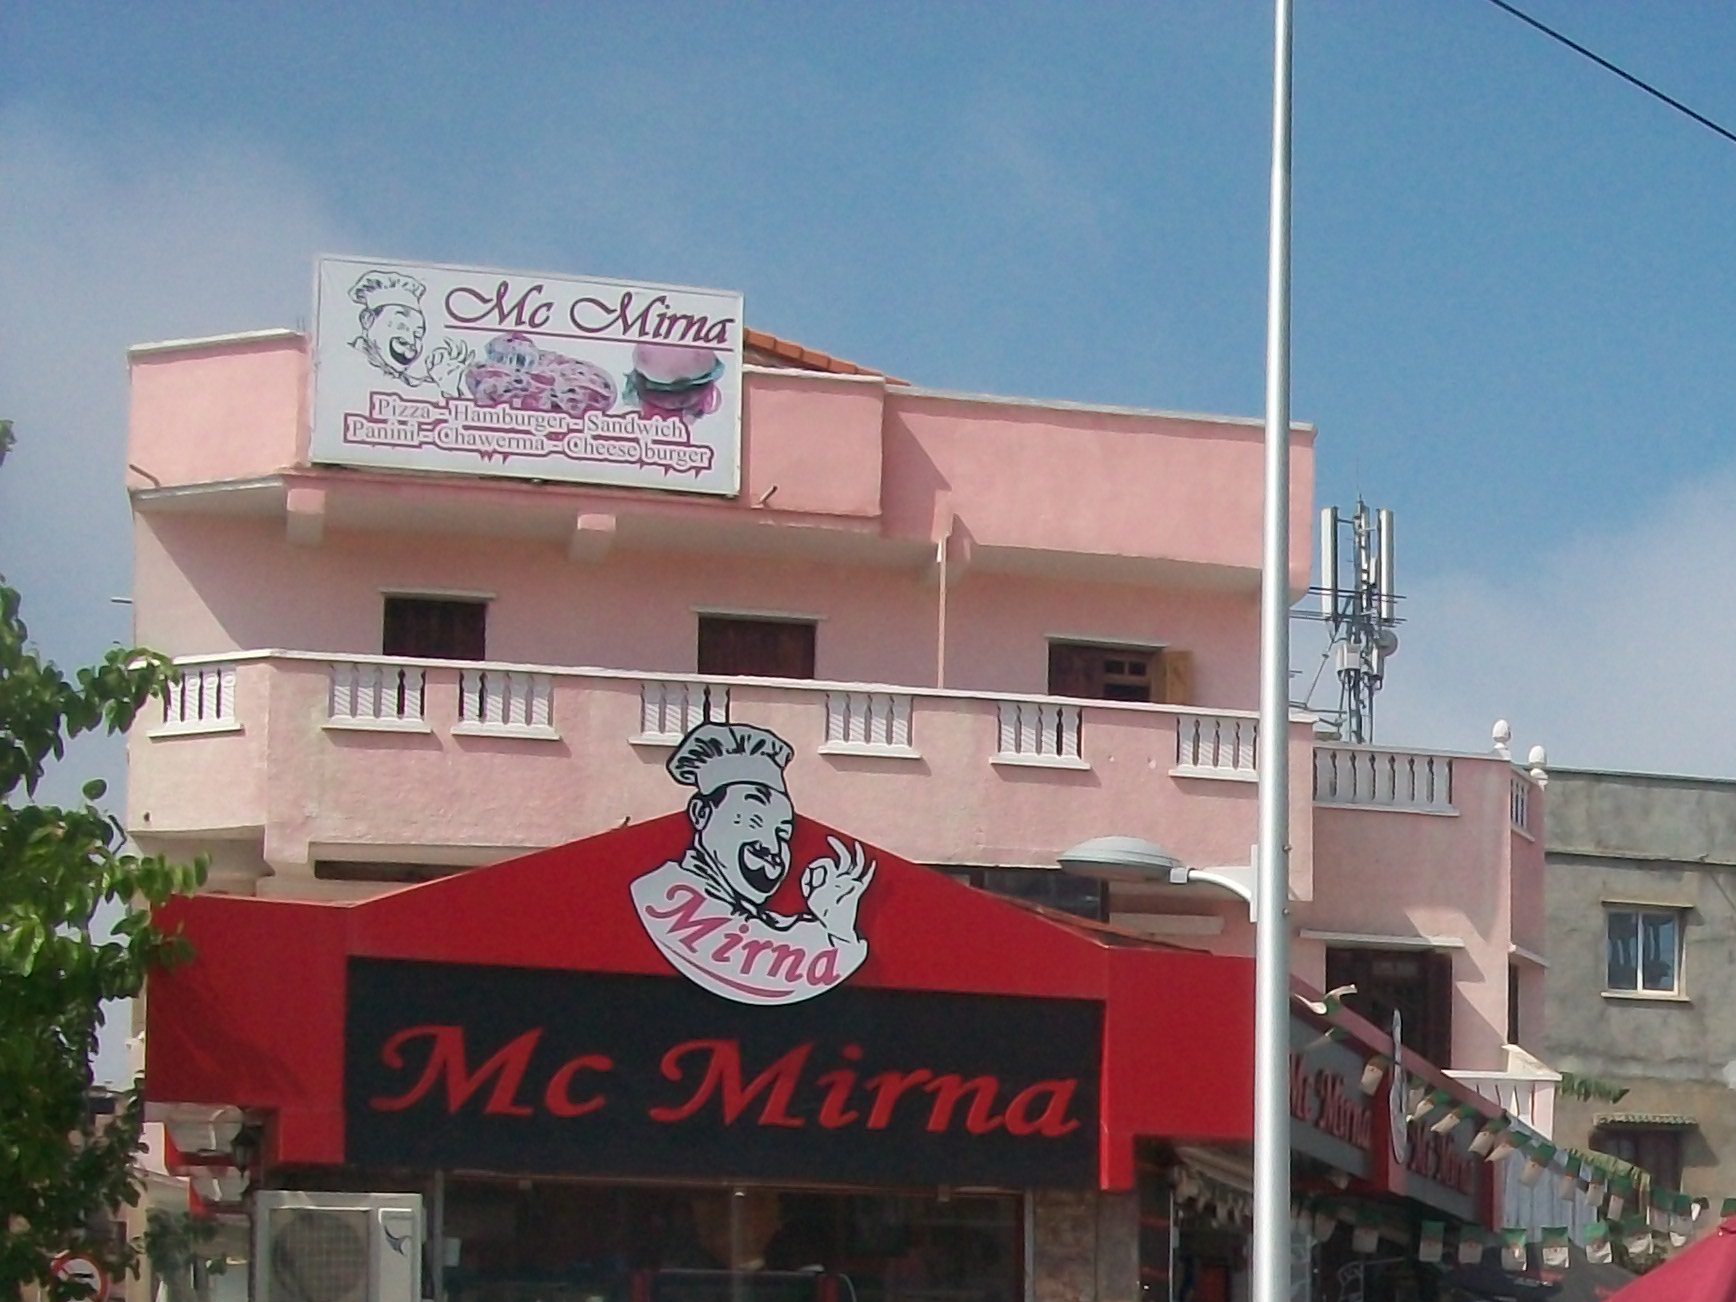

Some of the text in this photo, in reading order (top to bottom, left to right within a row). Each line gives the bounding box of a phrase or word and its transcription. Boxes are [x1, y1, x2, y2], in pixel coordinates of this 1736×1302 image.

[444, 280, 736, 344] Mc Mirna
[352, 419, 415, 442] Panini
[437, 428, 545, 451] Chawerma
[567, 436, 638, 458] Cheese
[644, 441, 708, 467] burger
[377, 398, 431, 419] Pizza
[454, 404, 566, 432] Hamburger
[586, 415, 683, 439] Sandwich
[645, 884, 841, 986] Mirna
[370, 1024, 1083, 1138] Mc Mirna
